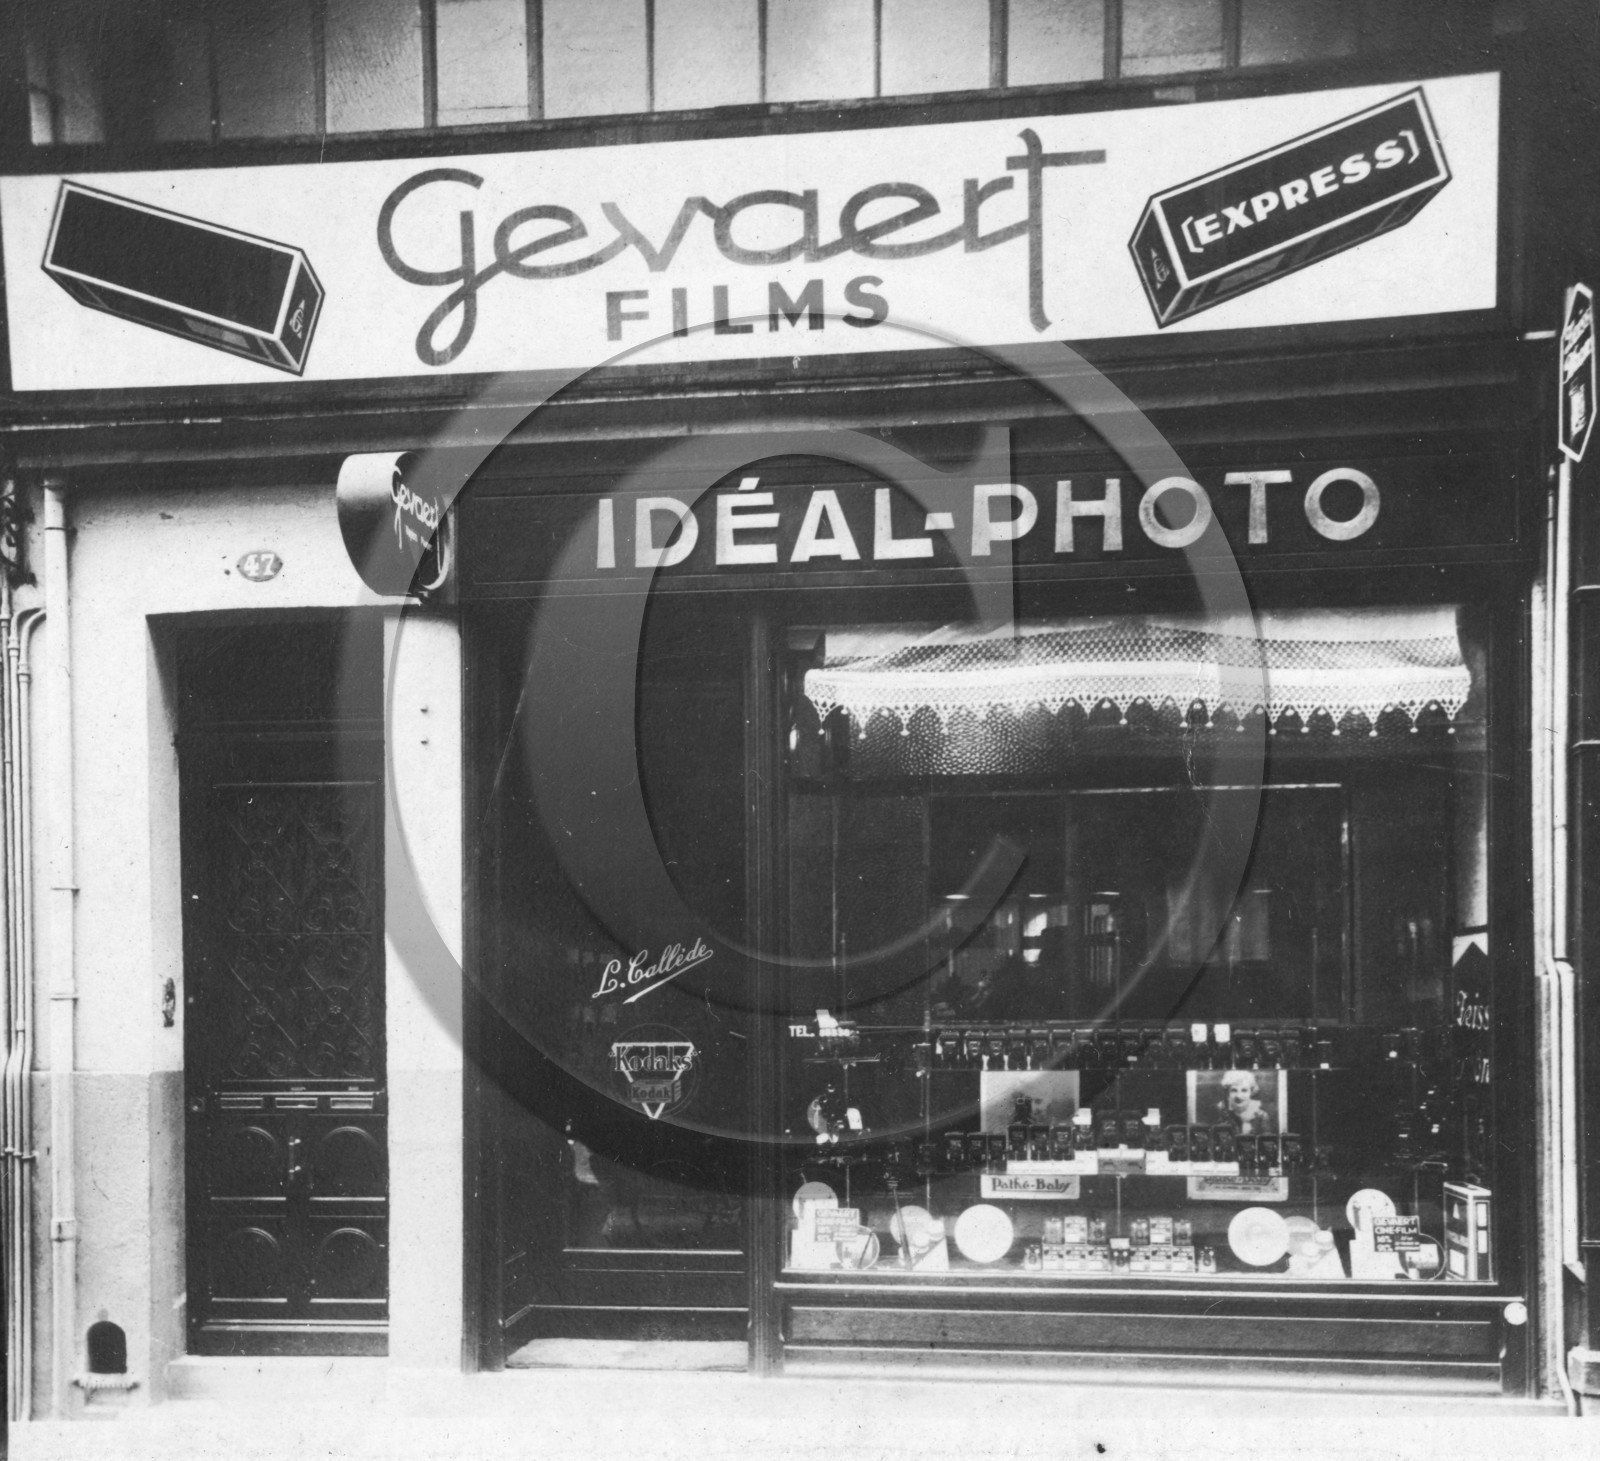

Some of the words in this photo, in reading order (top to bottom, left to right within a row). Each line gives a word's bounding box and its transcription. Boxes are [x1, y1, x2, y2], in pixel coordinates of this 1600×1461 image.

[377, 128, 1106, 364] Gevaert
[606, 277, 889, 341] FILMS
[596, 467, 1381, 570] IDÉAL-PHOTO
[243, 553, 275, 577] 47
[614, 1045, 693, 1072] Kodaks
[632, 1086, 671, 1098] Kodak
